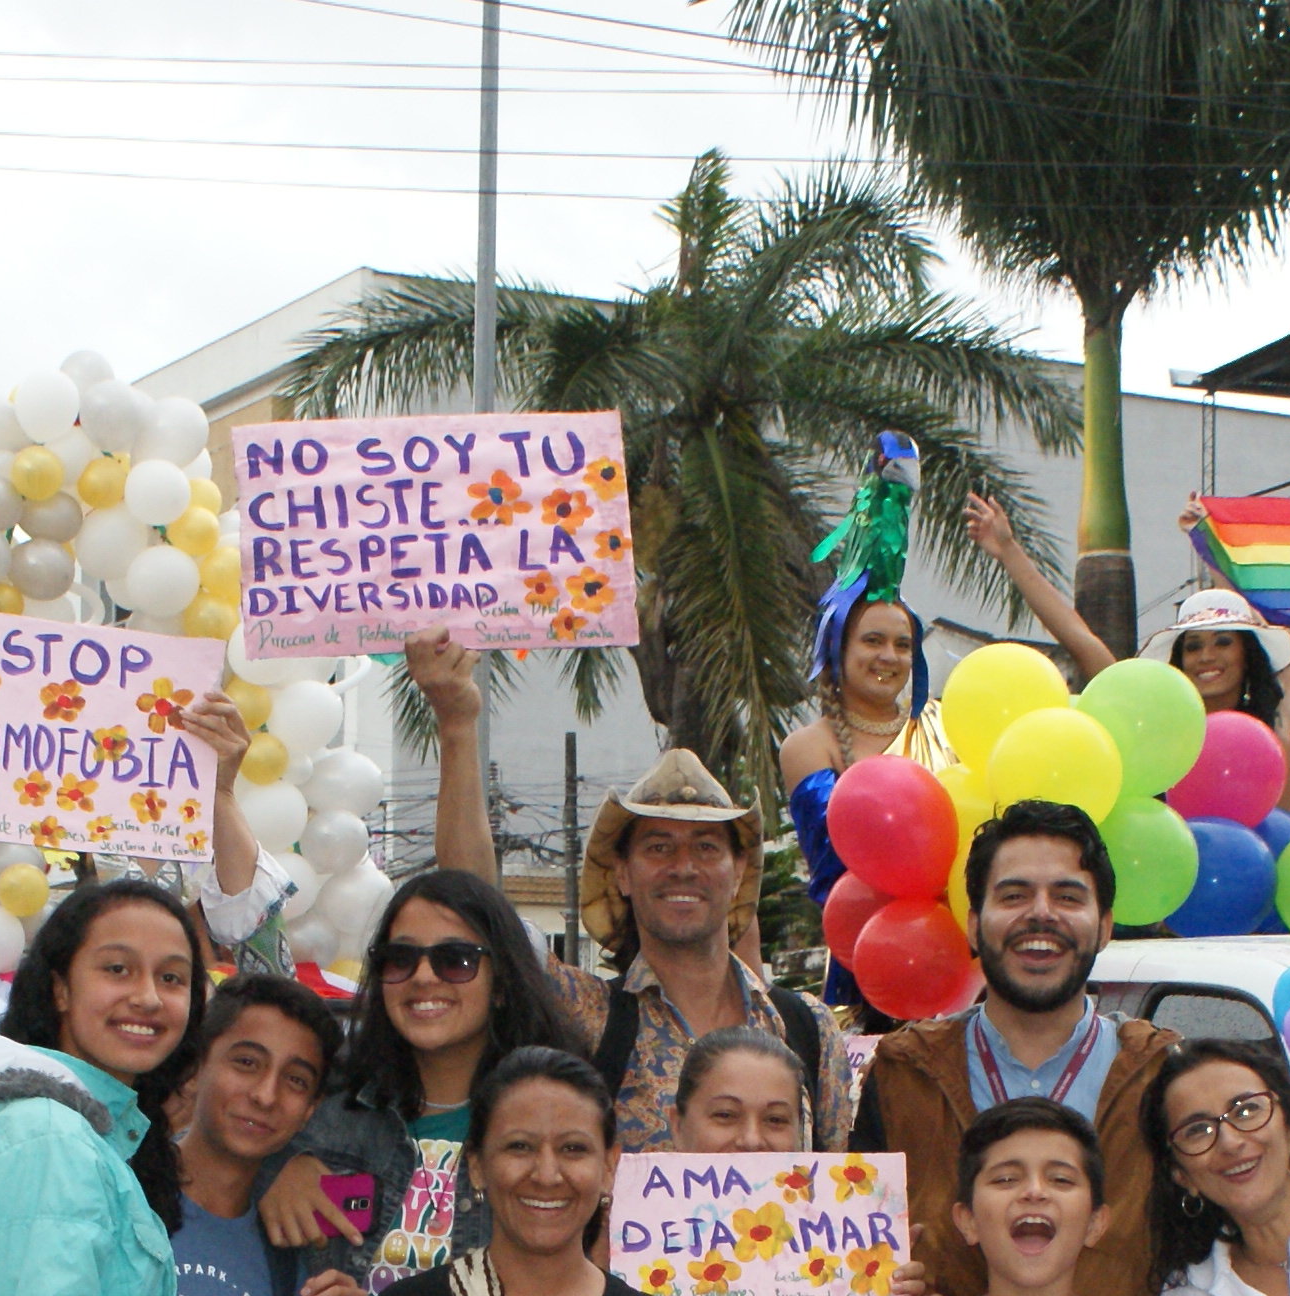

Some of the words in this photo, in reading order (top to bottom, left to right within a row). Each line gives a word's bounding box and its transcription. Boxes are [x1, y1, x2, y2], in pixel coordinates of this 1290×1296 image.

[246, 438, 329, 478] NO
[357, 433, 476, 475] SOY
[499, 431, 585, 477] TU
[253, 532, 493, 582] RESPETA
[519, 525, 585, 571] LA
[248, 581, 499, 617] DIVERSIDAD
[324, 624, 341, 645] de
[0, 629, 153, 689] STOP
[642, 1165, 752, 1199] AMA
[622, 1216, 738, 1258] DEJA
